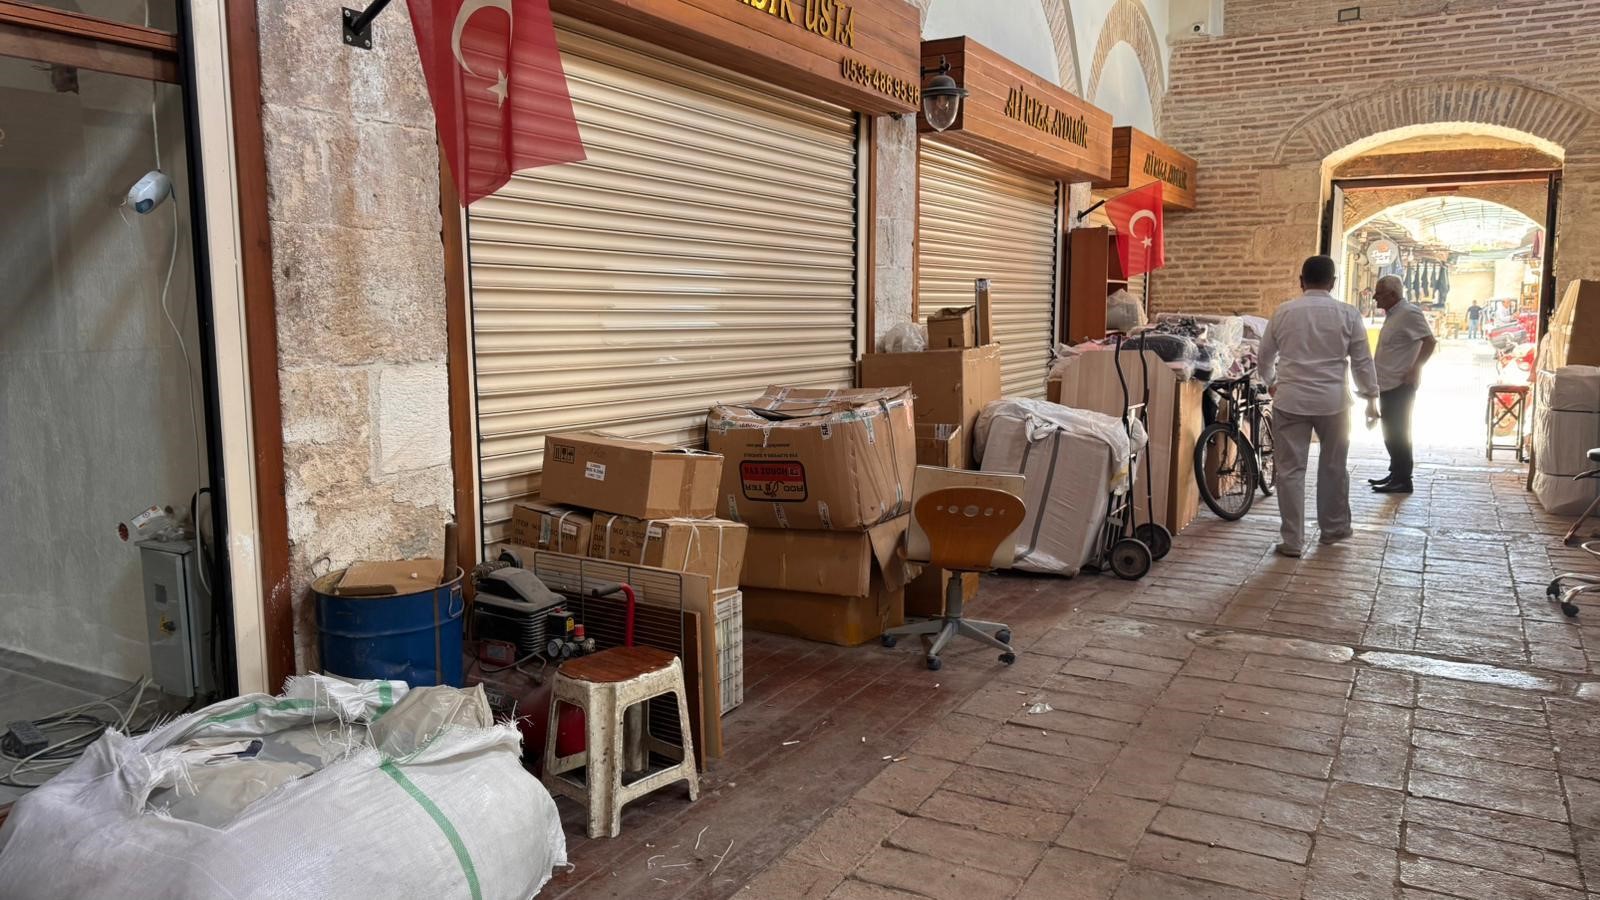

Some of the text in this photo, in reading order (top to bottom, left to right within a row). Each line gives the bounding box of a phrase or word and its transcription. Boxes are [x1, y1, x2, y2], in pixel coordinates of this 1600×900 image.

[804, 0, 856, 48] USTA
[842, 56, 921, 106] 0535 486 95 96
[1004, 84, 1024, 122] ALİ
[1023, 94, 1050, 134] RIZA
